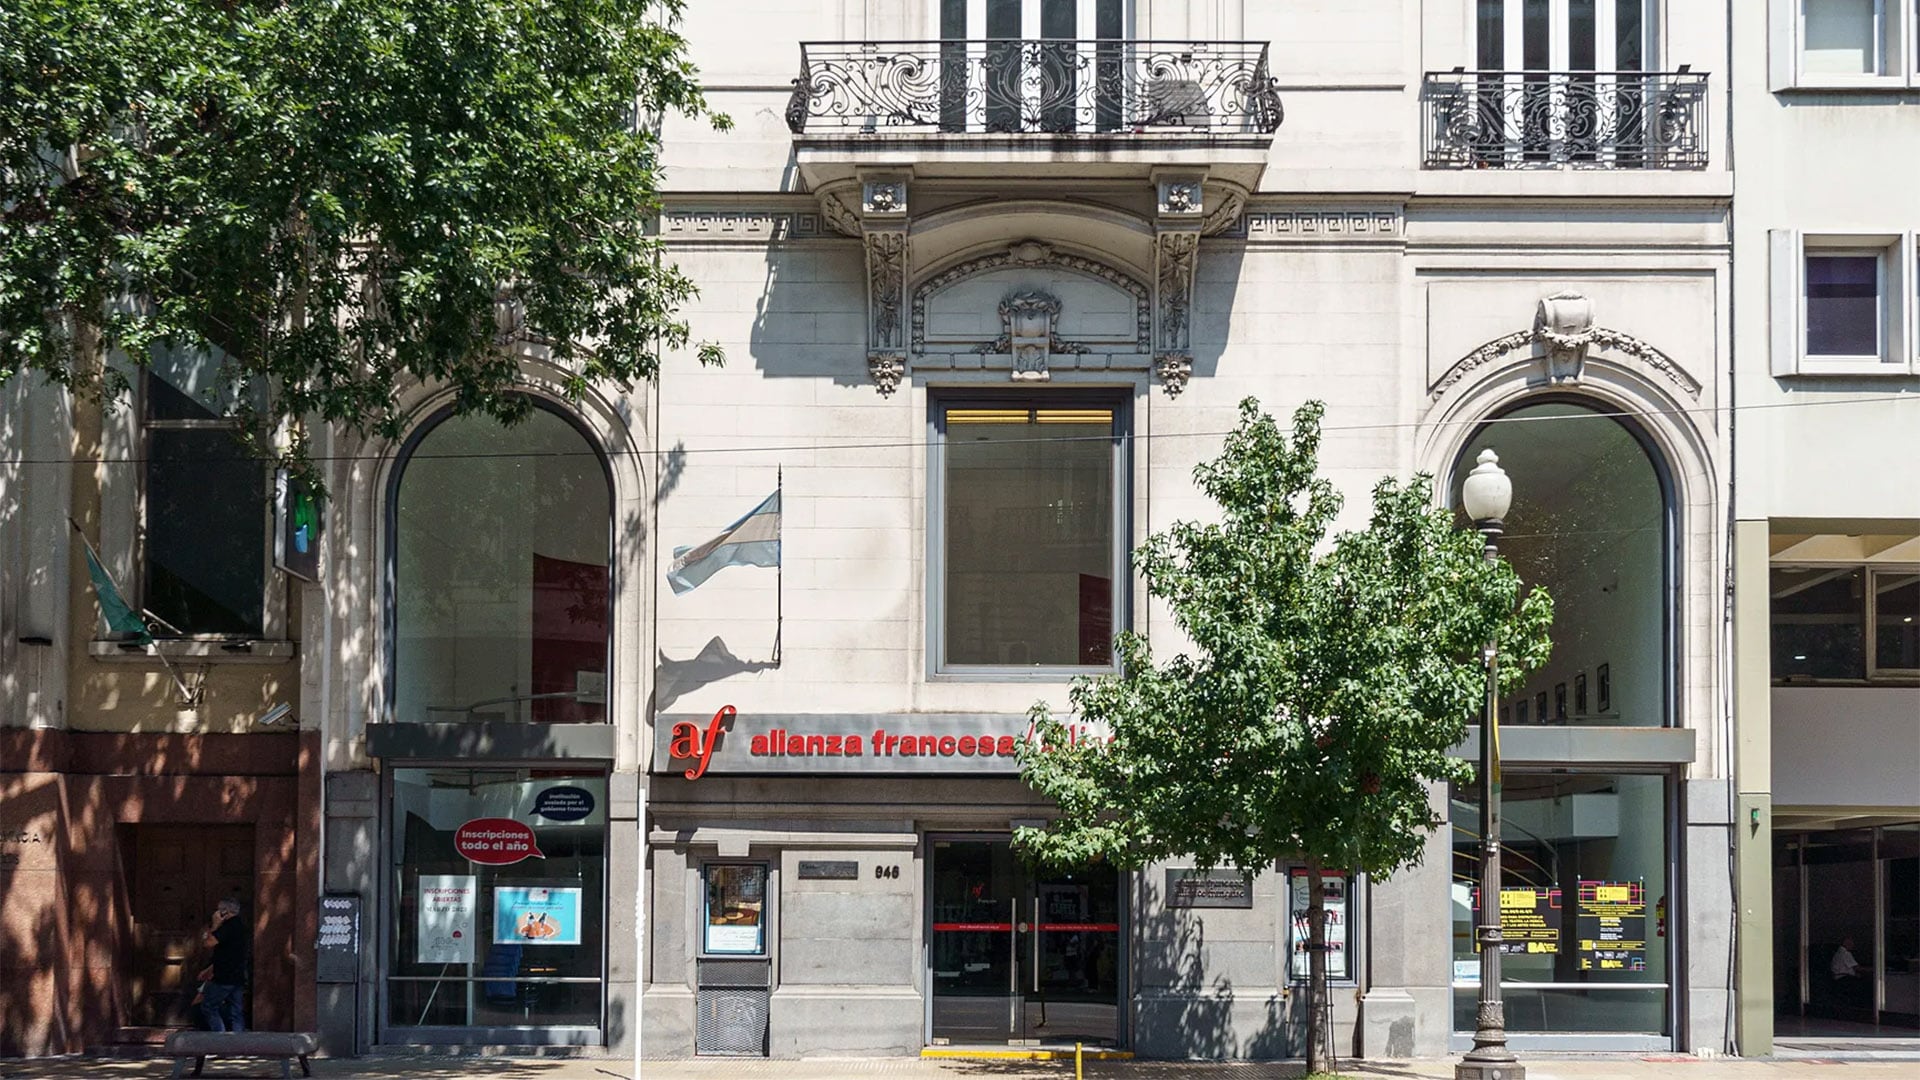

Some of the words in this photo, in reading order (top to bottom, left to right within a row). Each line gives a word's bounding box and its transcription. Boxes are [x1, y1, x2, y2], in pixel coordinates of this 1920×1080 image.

[668, 704, 737, 780] af
[751, 729, 863, 757] alianza
[871, 729, 1016, 757] francesa
[462, 830, 529, 840] Inscripciones
[461, 841, 489, 850] todo
[492, 841, 503, 850] el
[506, 841, 529, 851] año
